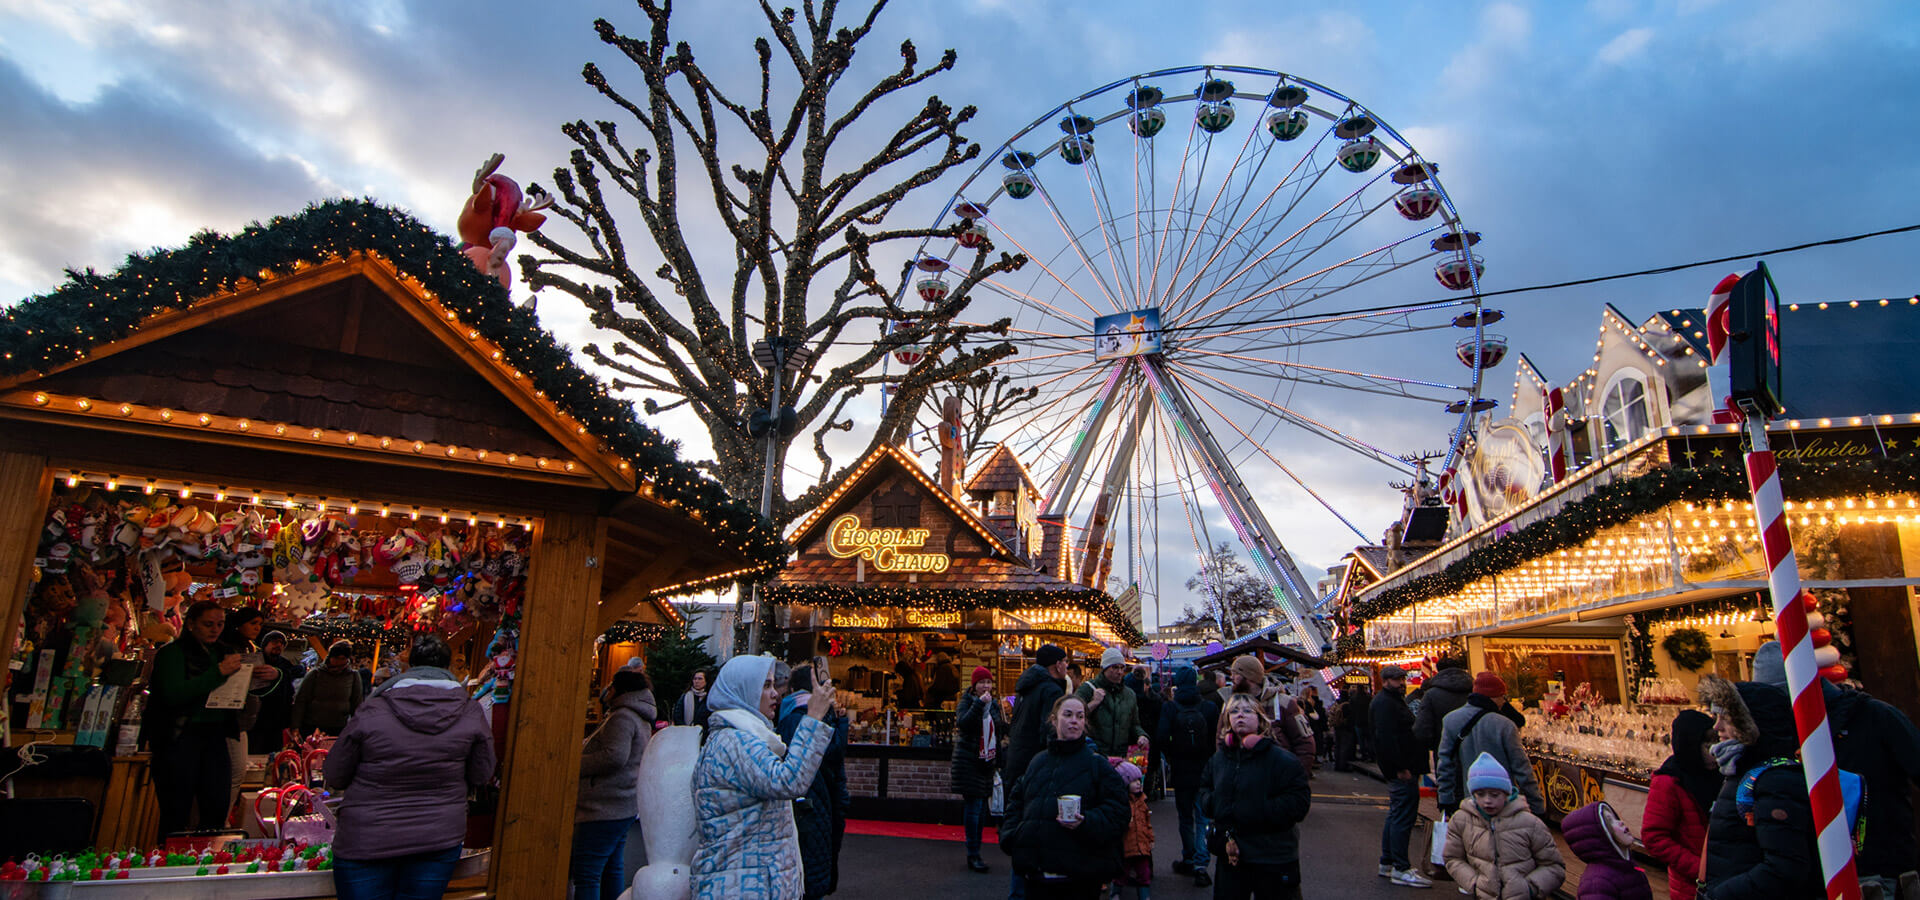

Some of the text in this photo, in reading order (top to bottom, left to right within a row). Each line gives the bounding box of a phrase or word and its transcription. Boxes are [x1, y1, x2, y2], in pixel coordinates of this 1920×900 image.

[832, 614, 889, 629] Cash only
[906, 611, 961, 624] Chocolat
